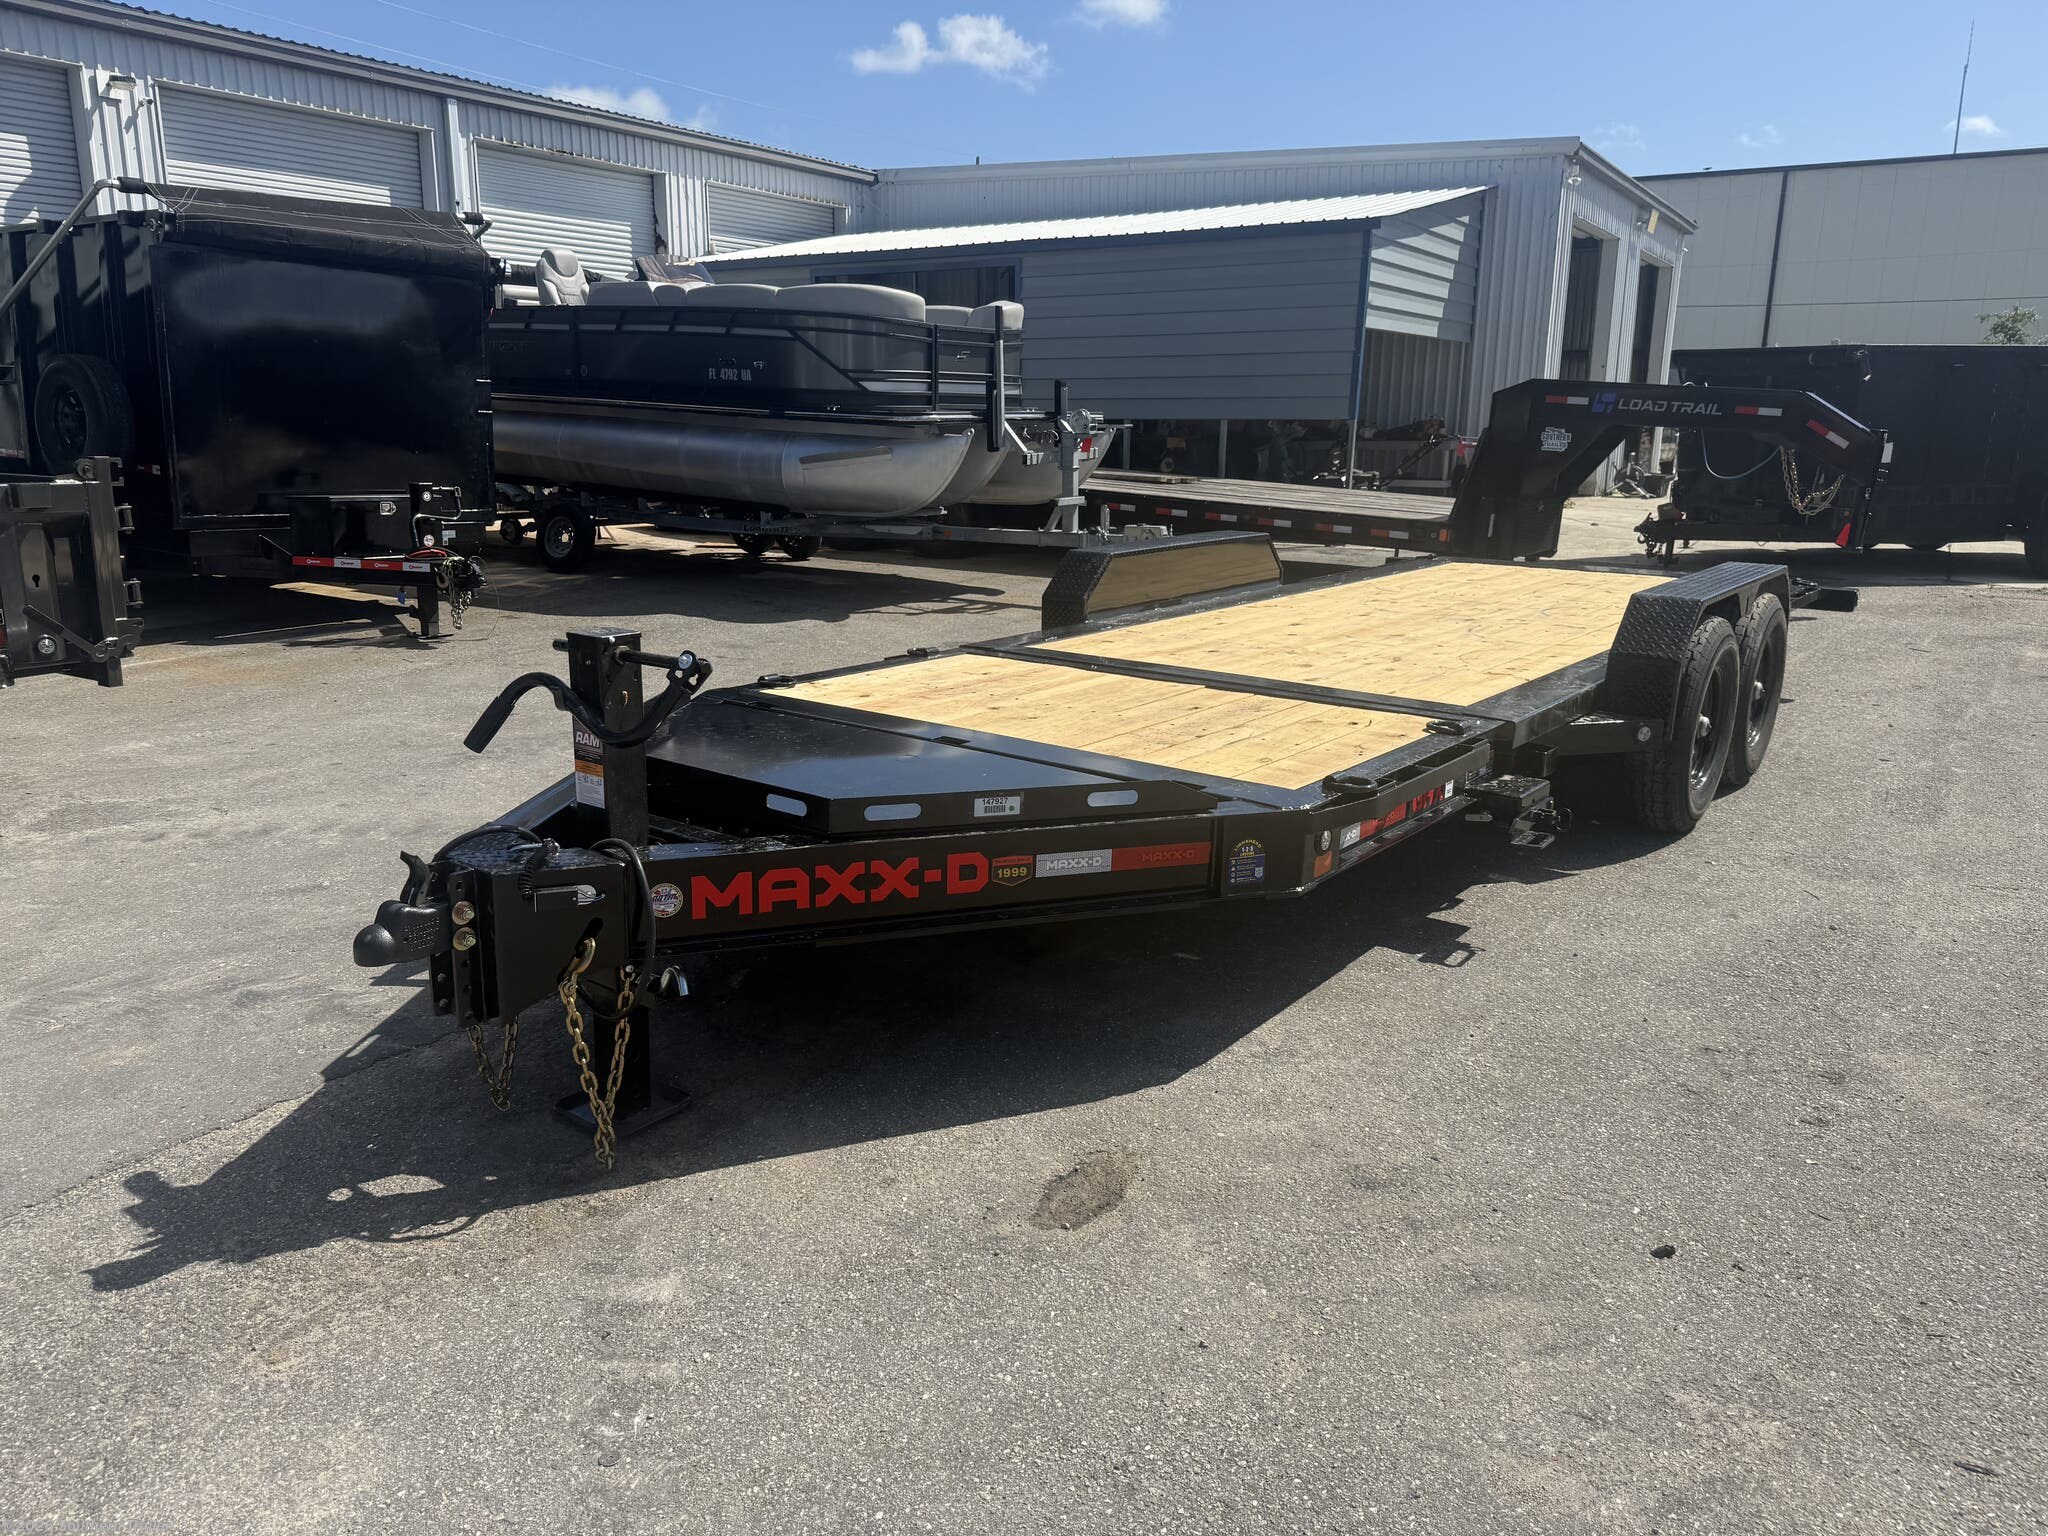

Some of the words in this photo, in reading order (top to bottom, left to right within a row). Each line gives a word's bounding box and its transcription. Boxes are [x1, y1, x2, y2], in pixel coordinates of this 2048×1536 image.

[708, 367, 717, 380] FL
[1617, 398, 1668, 412] LOAD
[1670, 401, 1722, 415] TRAIL
[575, 731, 600, 748] RAM
[982, 797, 1008, 806] 147927
[1142, 848, 1195, 862] MAXX-D
[1046, 856, 1102, 871] MAXX-D
[997, 866, 1028, 879] 1999
[691, 851, 989, 920] MAXX-D
